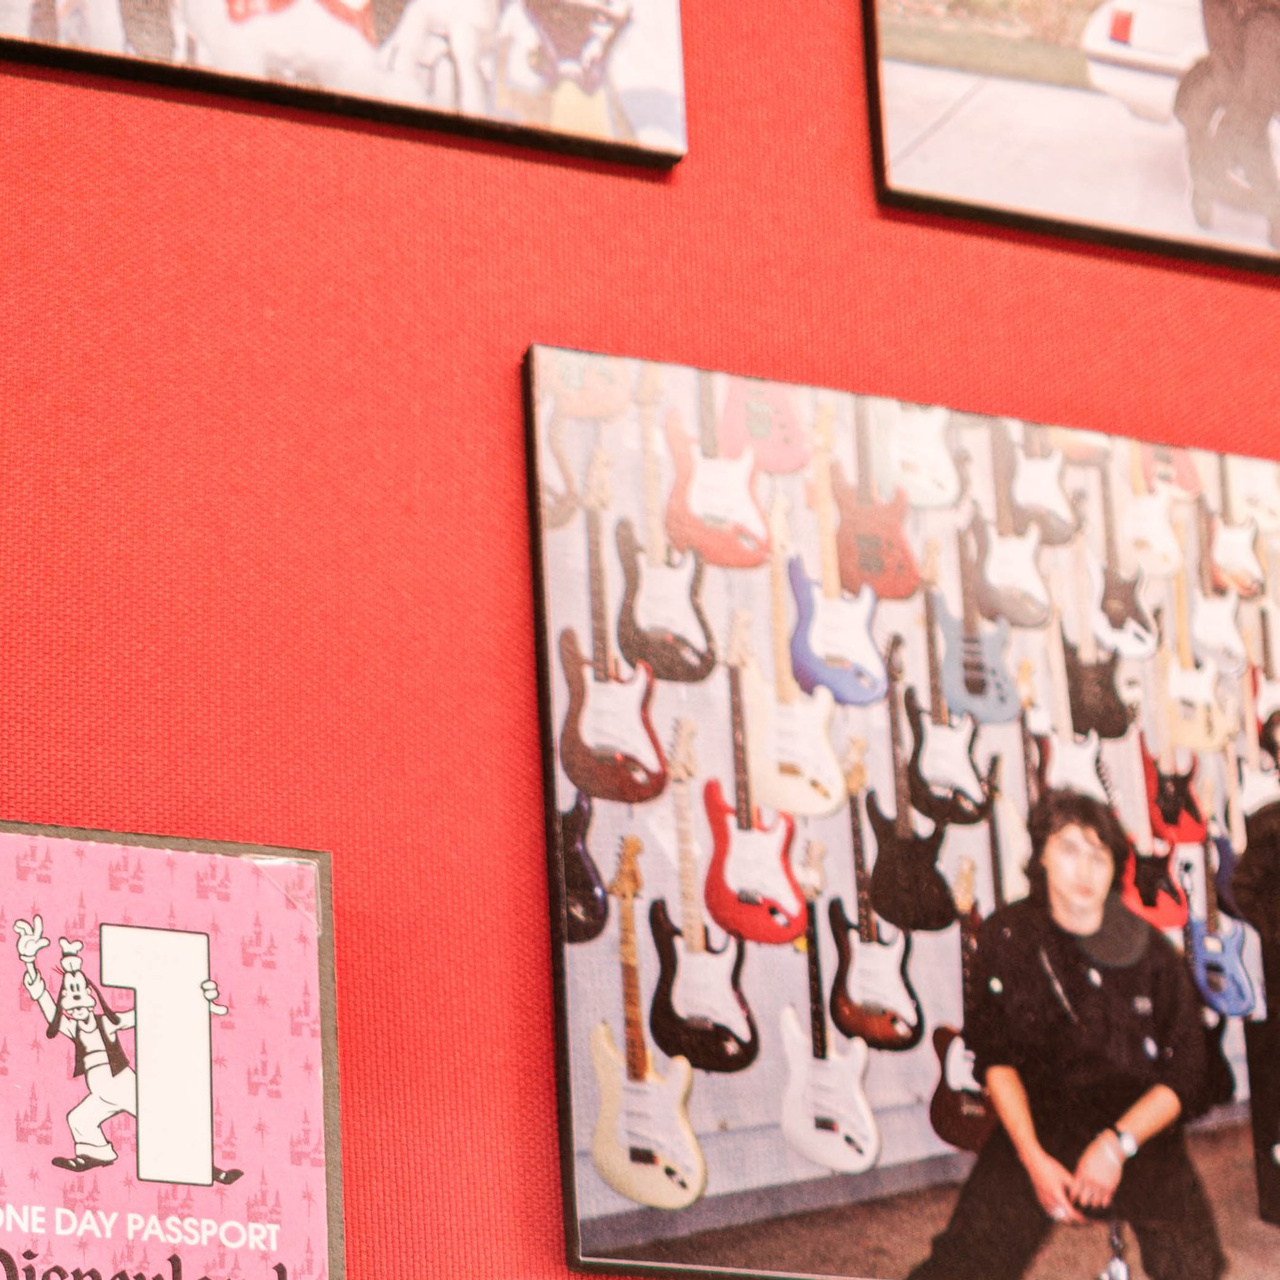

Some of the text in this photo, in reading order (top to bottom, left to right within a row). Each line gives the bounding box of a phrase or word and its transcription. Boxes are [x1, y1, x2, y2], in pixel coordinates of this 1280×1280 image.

[99, 922, 214, 1186] 1
[55, 1207, 118, 1238] DAY
[127, 1213, 280, 1251] PASSPORT
